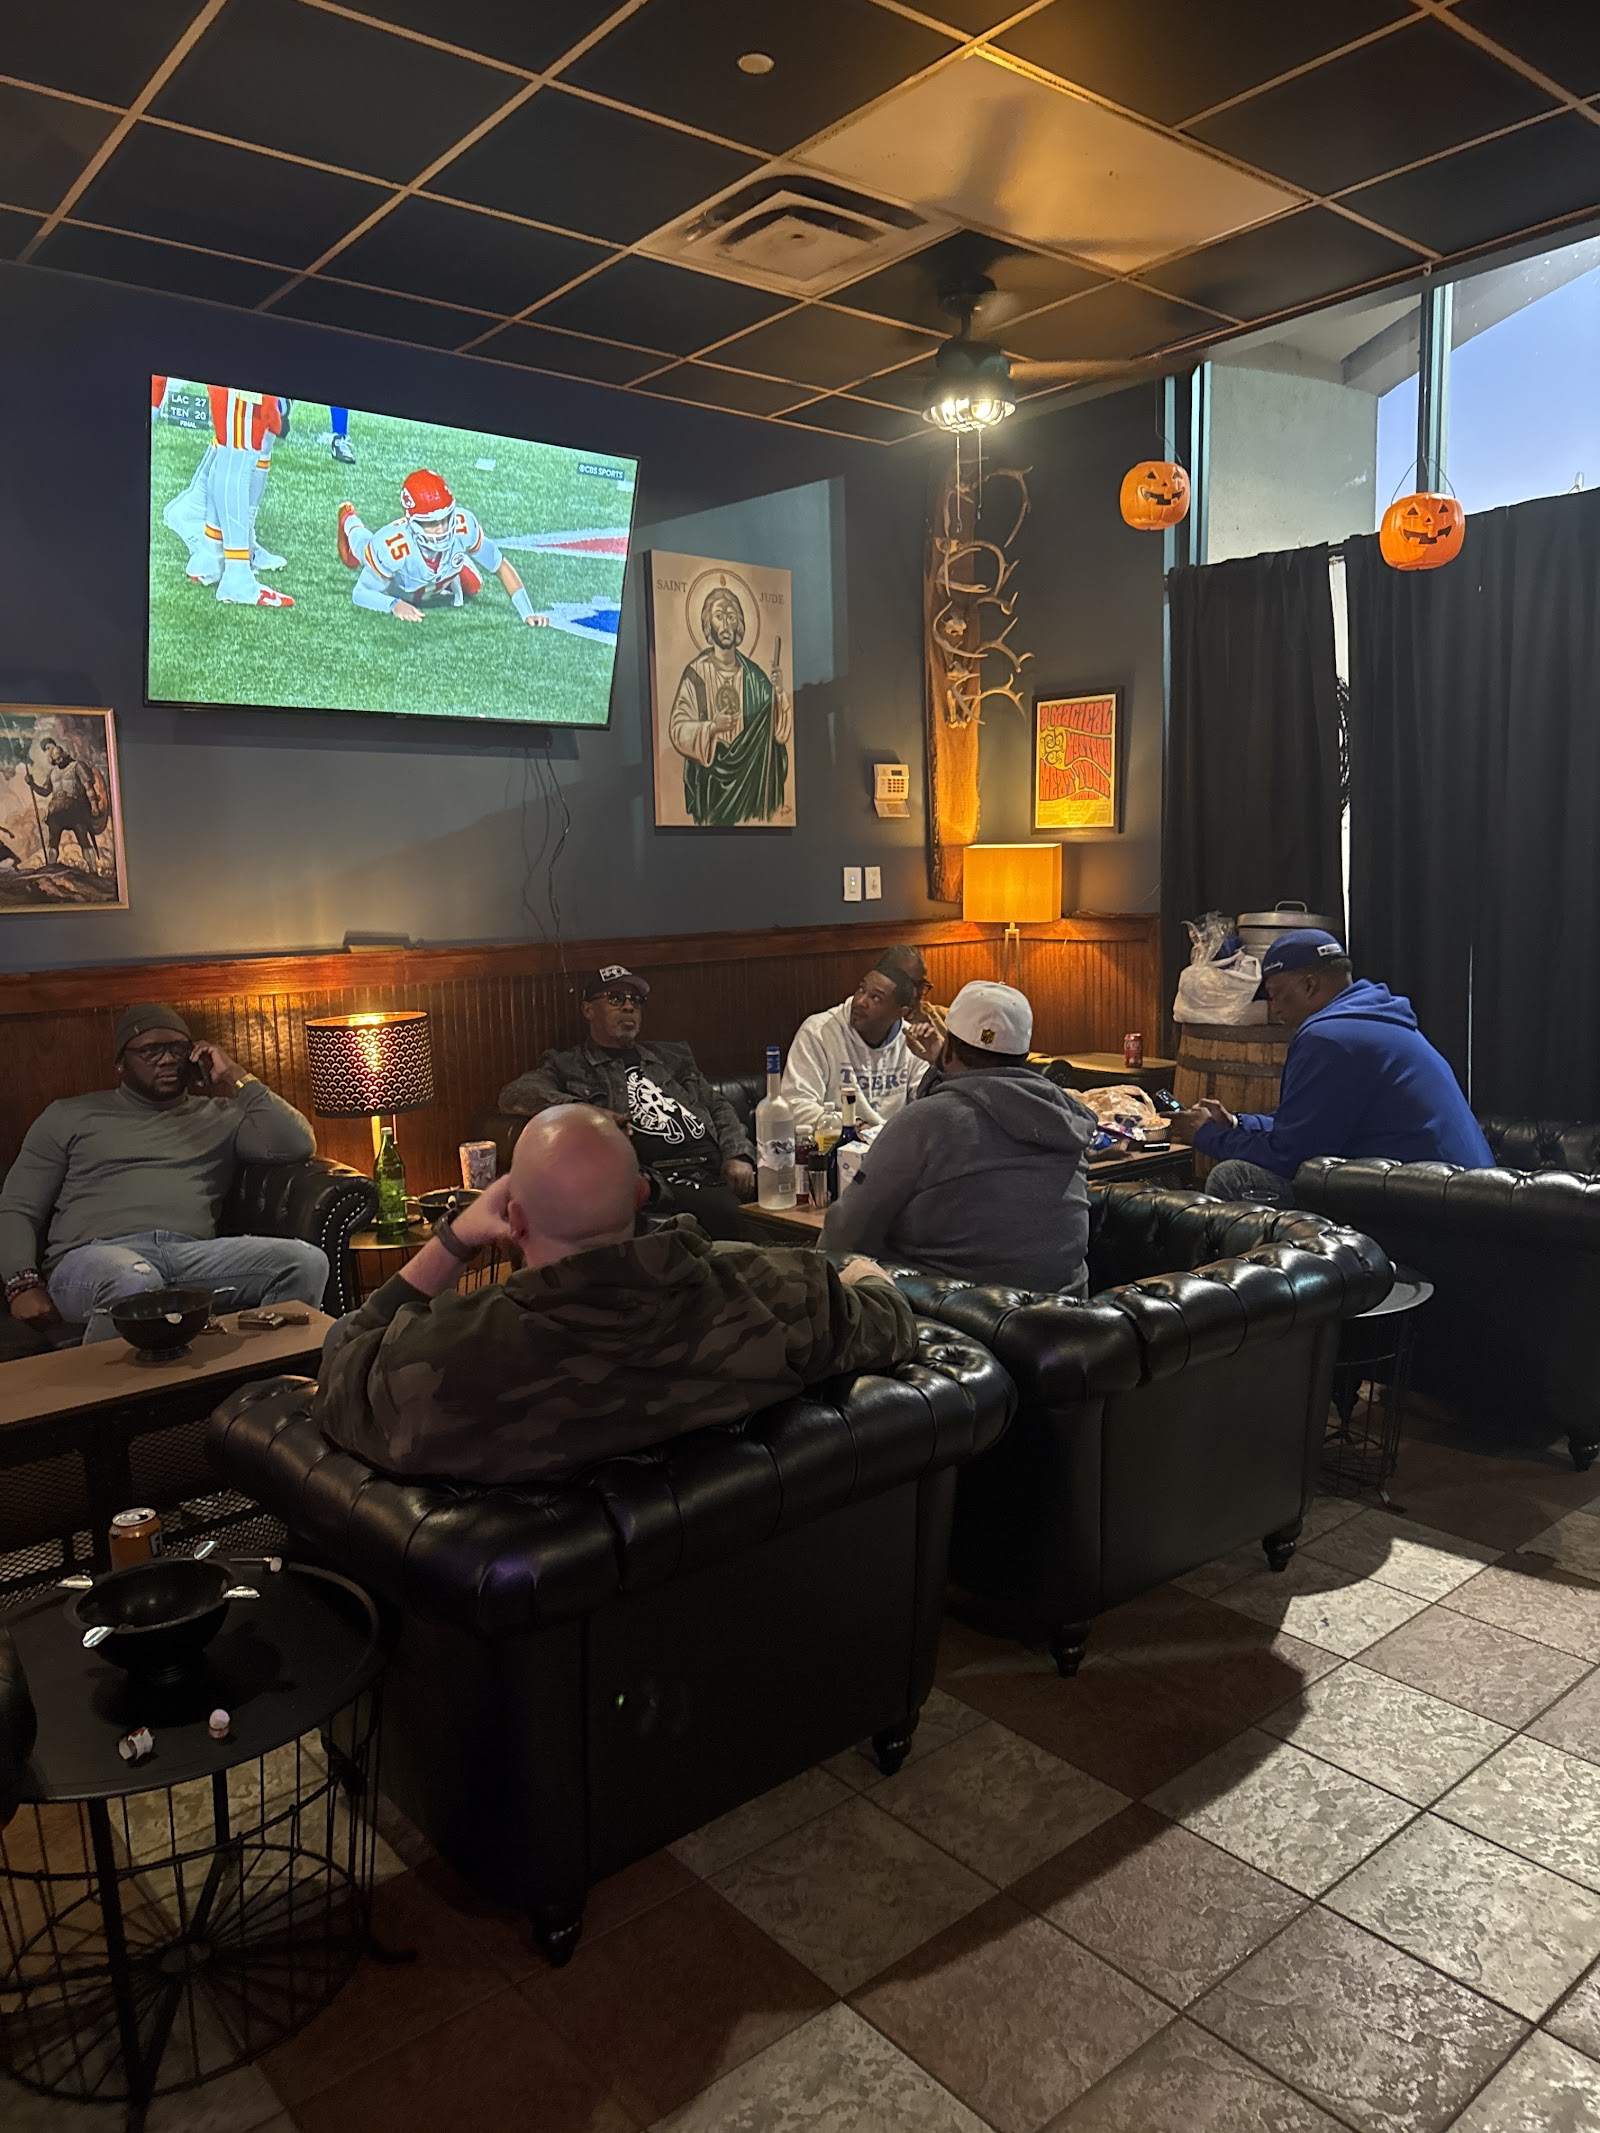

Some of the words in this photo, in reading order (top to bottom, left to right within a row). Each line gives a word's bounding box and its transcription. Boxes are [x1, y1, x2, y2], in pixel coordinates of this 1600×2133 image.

[171, 394, 189, 405] LAC
[195, 397, 206, 407] 27
[170, 406, 189, 417] TEN
[194, 411, 206, 421] 20
[180, 420, 197, 429] FINAL
[585, 465, 597, 475] CBS
[598, 467, 623, 479] SPORTS
[384, 532, 411, 561] 15
[657, 579, 687, 593] SAINT
[759, 592, 784, 605] JUDE
[1050, 701, 1112, 735] MAGICAL
[1064, 731, 1111, 777] MYSTERY
[840, 1067, 909, 1091] TGERS
